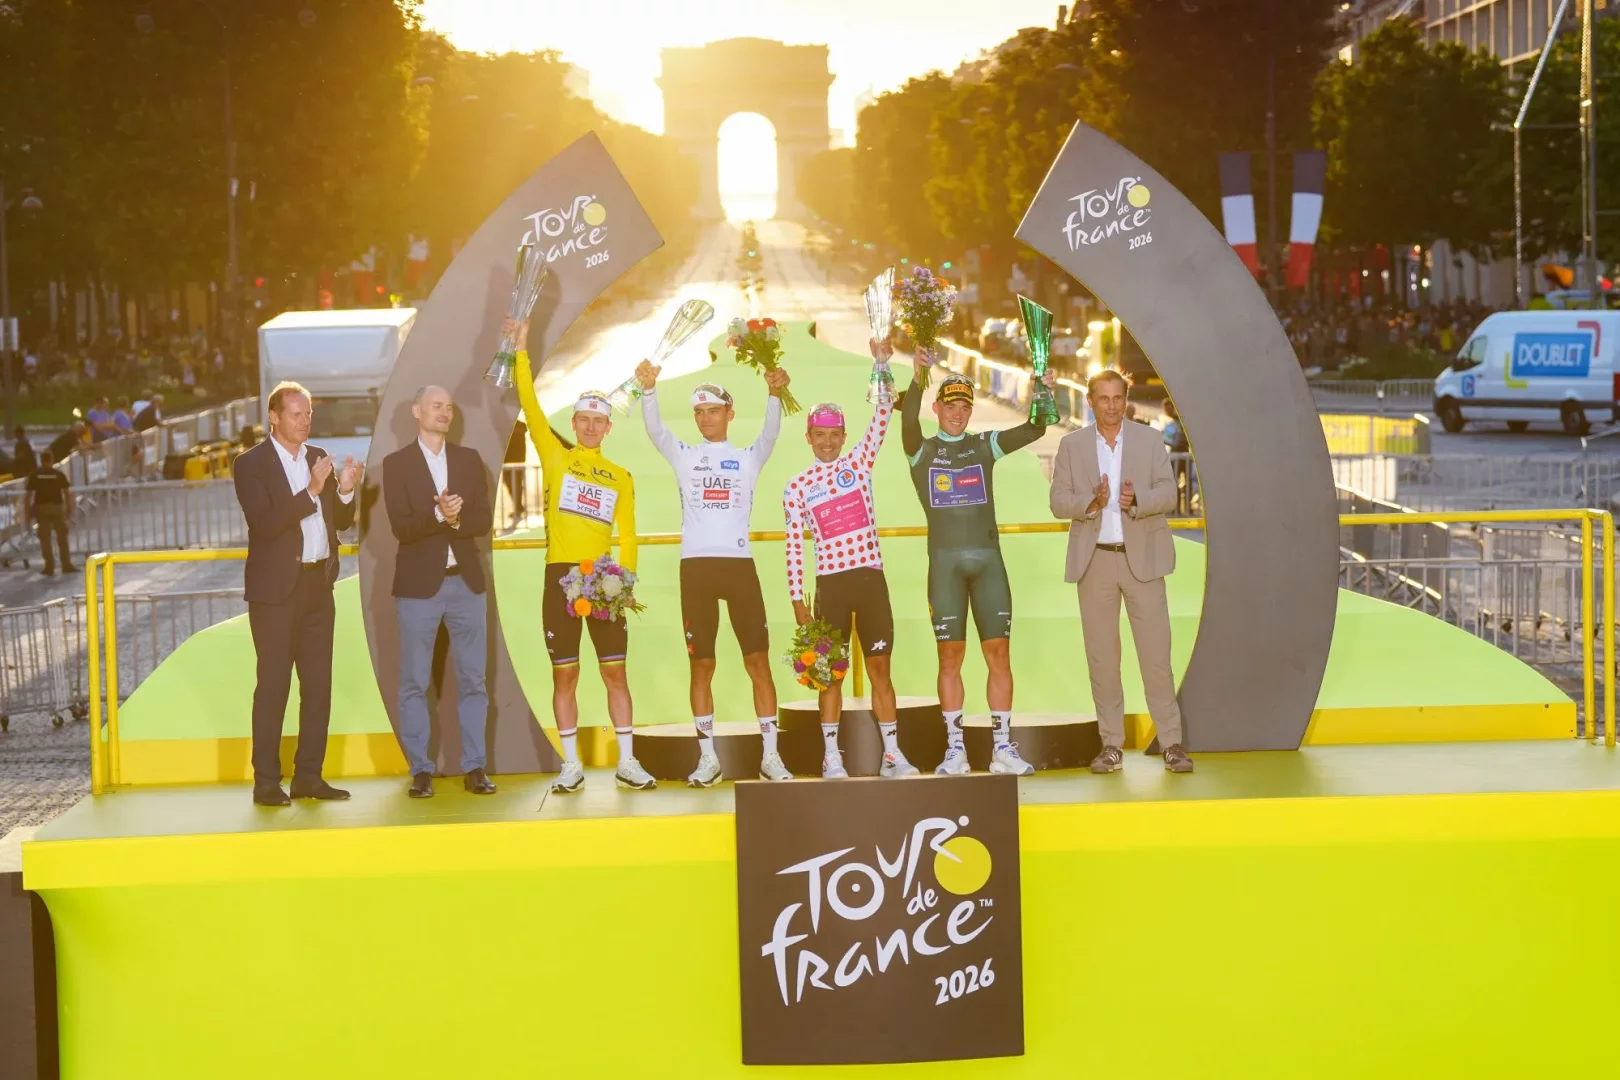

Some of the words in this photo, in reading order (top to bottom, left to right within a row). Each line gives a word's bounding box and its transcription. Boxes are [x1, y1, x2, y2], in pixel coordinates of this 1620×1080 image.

[1067, 176, 1134, 223] TOUR
[1116, 203, 1128, 215] de
[522, 194, 597, 242] TOUR
[573, 221, 586, 234] de
[1128, 232, 1152, 251] 2026
[585, 250, 610, 269] 2026
[1517, 343, 1585, 368] DOUBLET
[592, 466, 617, 482] LCL
[703, 477, 731, 489] UAE
[578, 486, 603, 500] UAE
[577, 504, 602, 517] XRG
[702, 502, 730, 510] XRG
[820, 508, 831, 518] EF
[775, 816, 963, 934] TOUR
[906, 881, 938, 916] de
[761, 899, 994, 1006] france
[935, 957, 996, 1006] 2026
